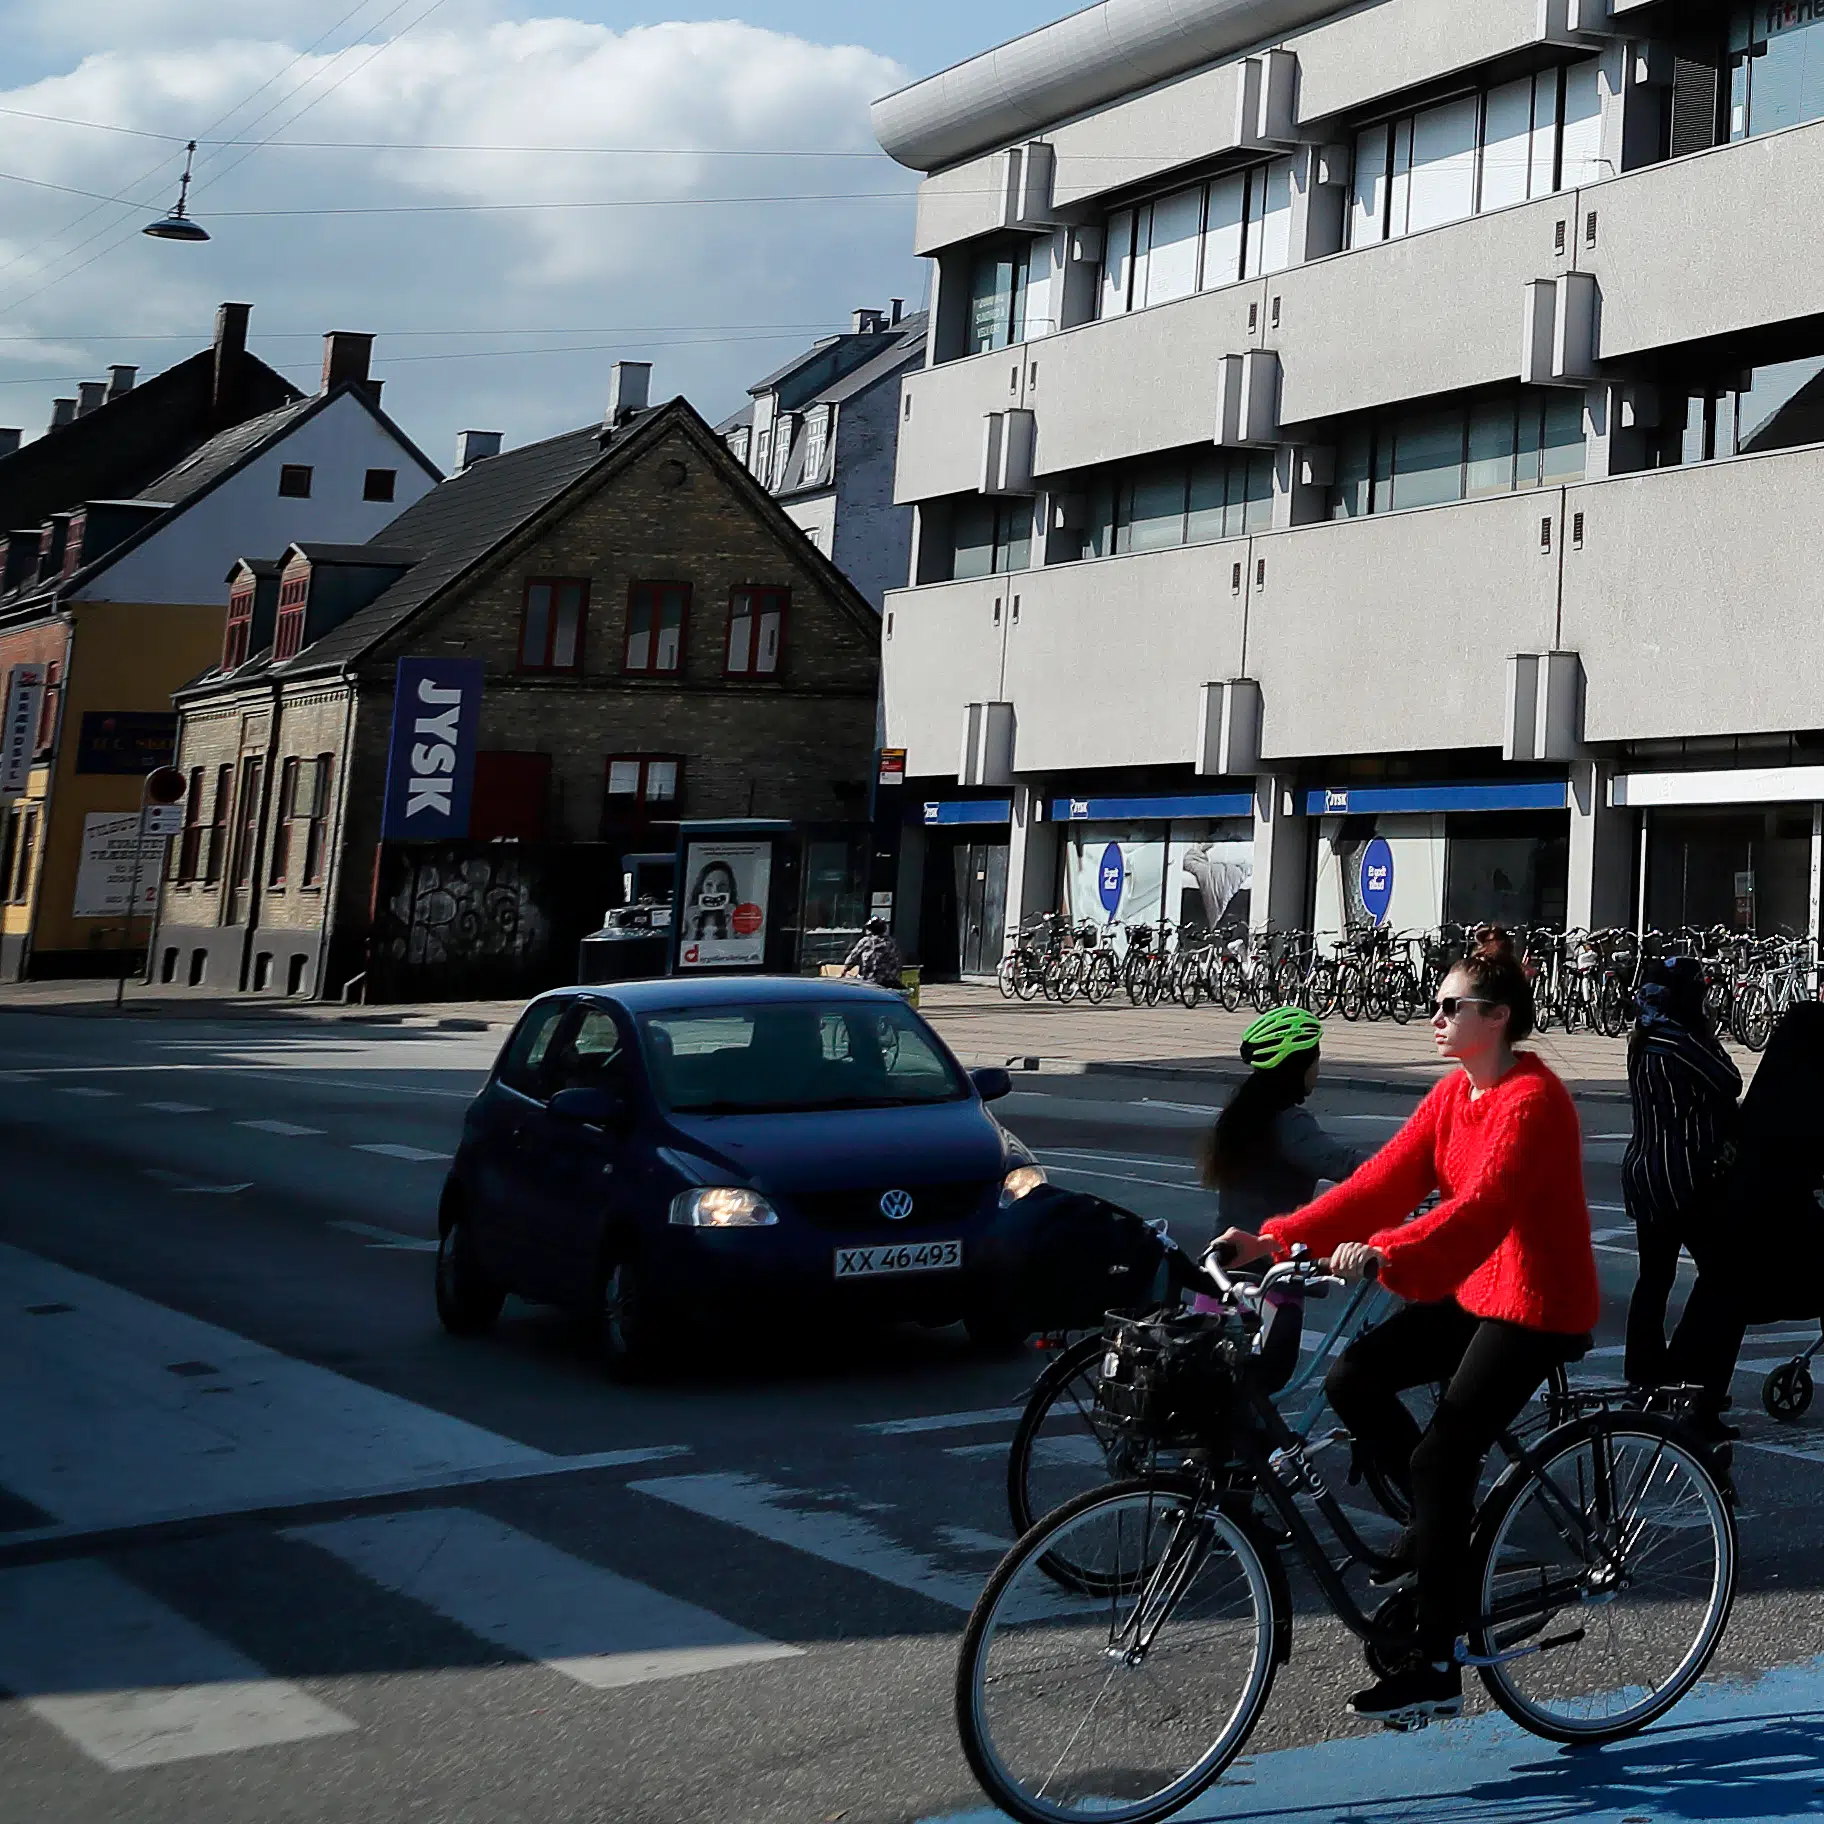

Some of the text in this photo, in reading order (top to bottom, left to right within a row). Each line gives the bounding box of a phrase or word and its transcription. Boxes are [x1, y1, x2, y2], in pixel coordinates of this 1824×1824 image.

[405, 678, 462, 819] JYSK
[1329, 793, 1347, 806] JYSK
[840, 1250, 874, 1273] XX
